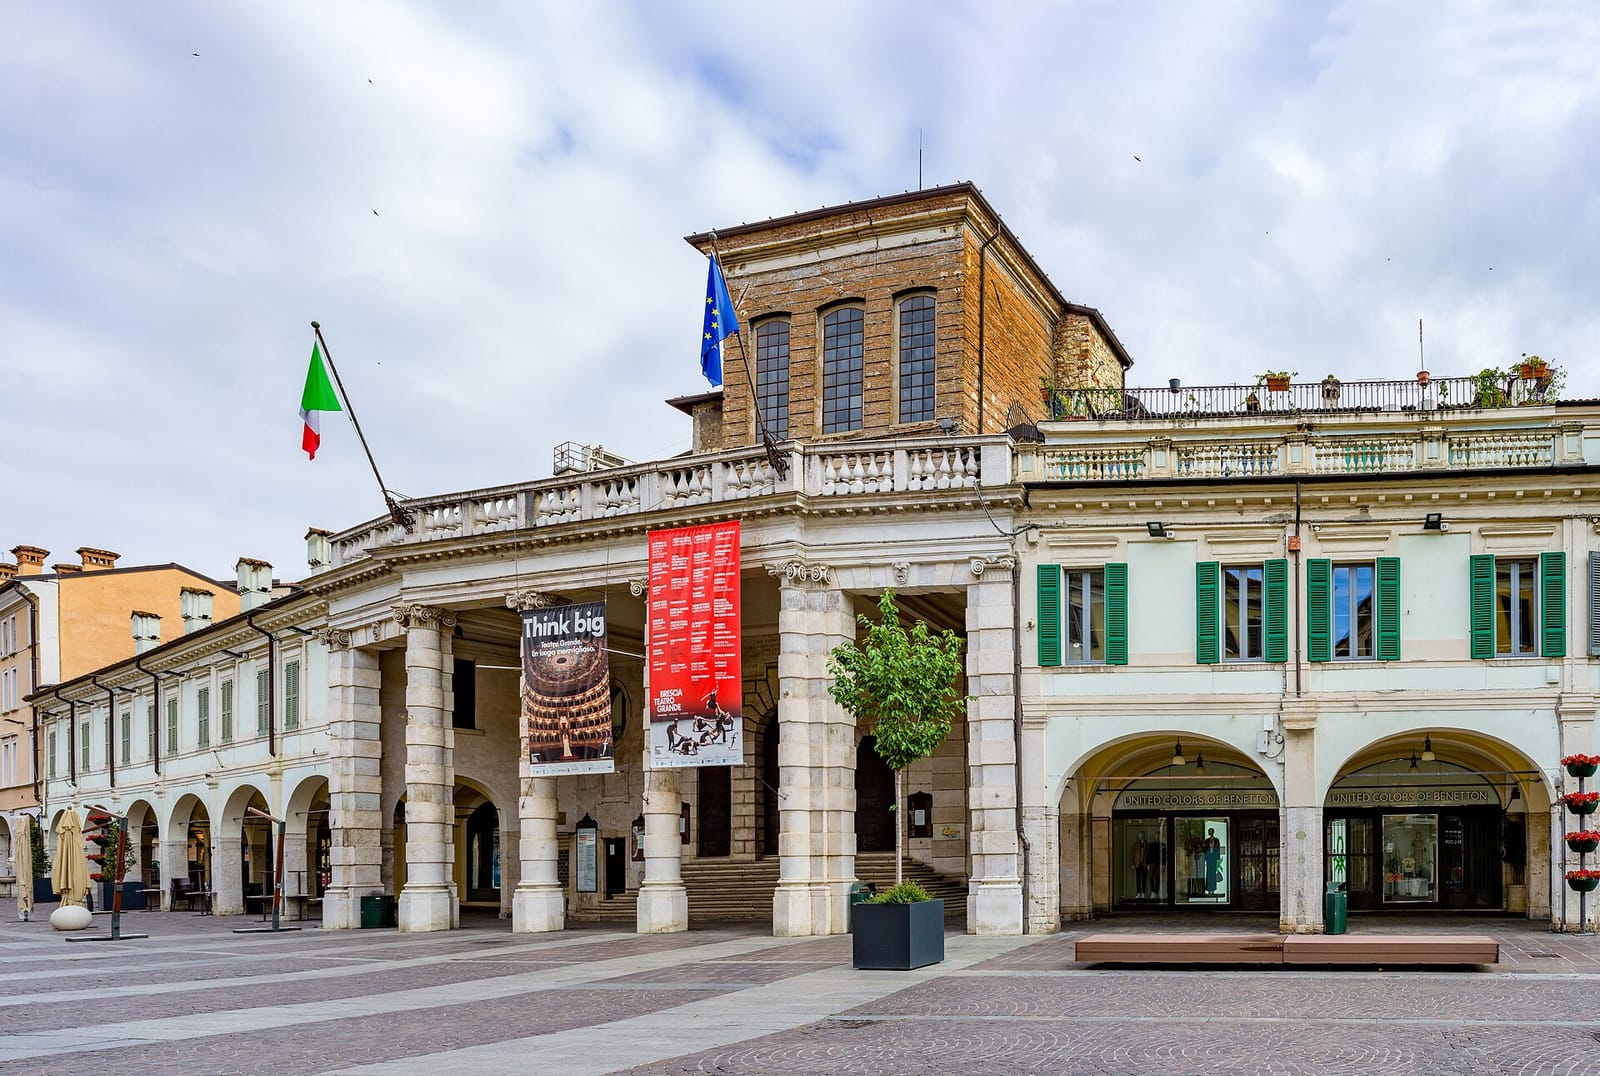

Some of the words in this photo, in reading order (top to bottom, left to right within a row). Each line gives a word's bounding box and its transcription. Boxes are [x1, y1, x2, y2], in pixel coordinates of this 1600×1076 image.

[523, 614, 570, 638] Think
[574, 611, 604, 637] big
[541, 641, 559, 649] Teatro
[539, 649, 556, 657] luogo
[660, 689, 683, 698] BRESCIA
[654, 697, 675, 705] TEATRO
[657, 703, 681, 712] GRANDE
[1125, 795, 1161, 806] UNITED
[1163, 795, 1203, 805] COLORS
[1207, 794, 1220, 804] OF
[1223, 793, 1276, 805] BENETTON
[1332, 792, 1370, 803] UNITED
[1372, 791, 1415, 802] COLORS
[1416, 791, 1430, 801] OF
[1433, 790, 1488, 801] BENETTON
